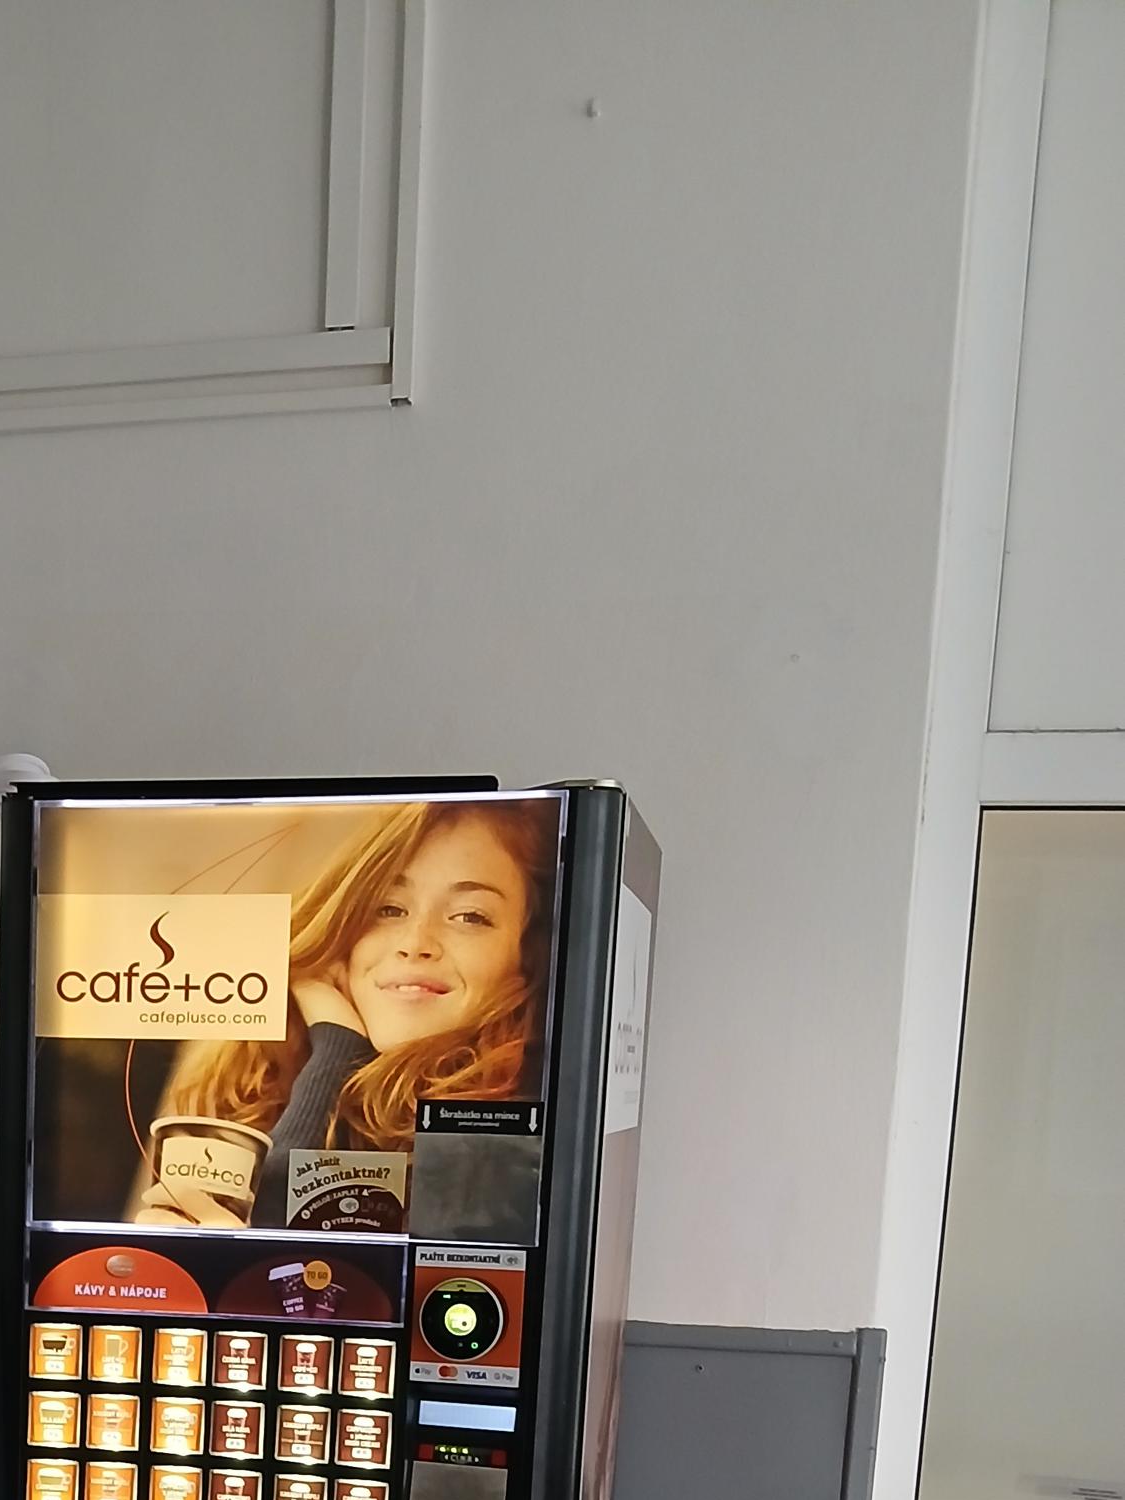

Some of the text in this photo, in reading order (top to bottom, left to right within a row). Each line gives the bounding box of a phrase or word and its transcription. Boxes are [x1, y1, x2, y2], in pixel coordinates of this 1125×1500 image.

[140, 1011, 267, 1026] cafeplusco.com
[296, 1163, 313, 1177] Jak
[74, 1282, 167, 1299] KÁVY & NÁPOJE
[465, 1370, 488, 1380] VISA
